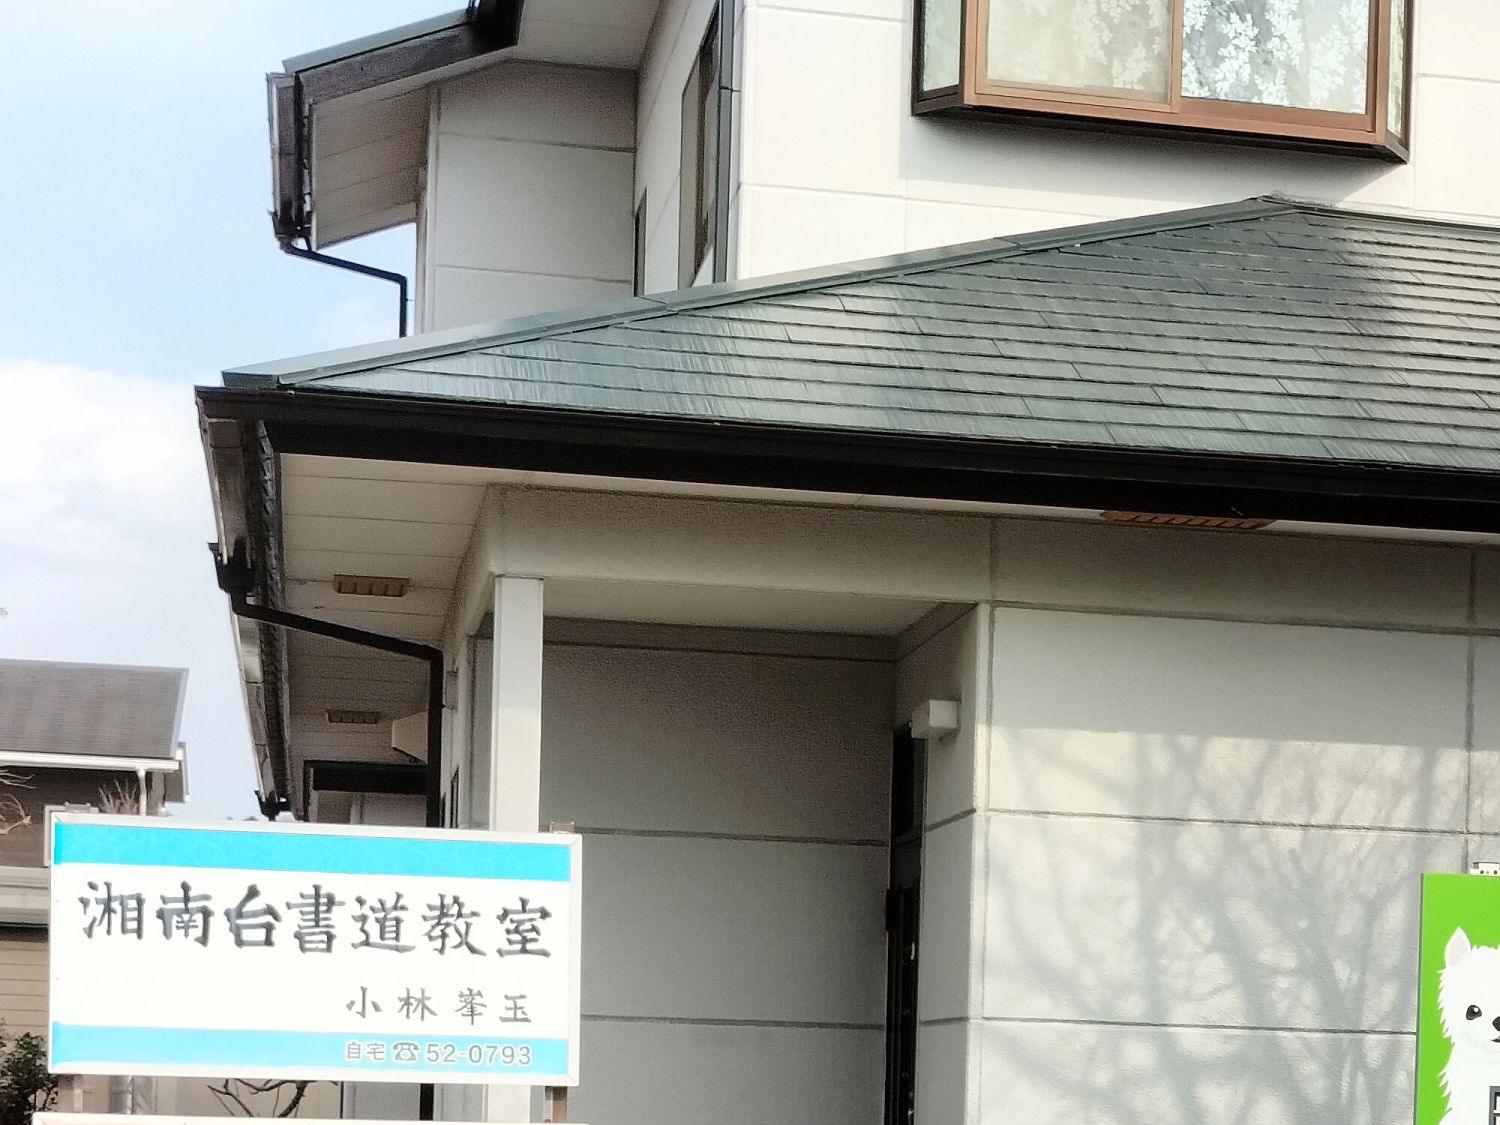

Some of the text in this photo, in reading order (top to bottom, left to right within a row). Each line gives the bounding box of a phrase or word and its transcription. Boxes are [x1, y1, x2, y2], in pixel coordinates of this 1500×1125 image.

[78, 880, 553, 958] 湘南台書道教室
[346, 1041, 532, 1065] 自宅 52-0793
